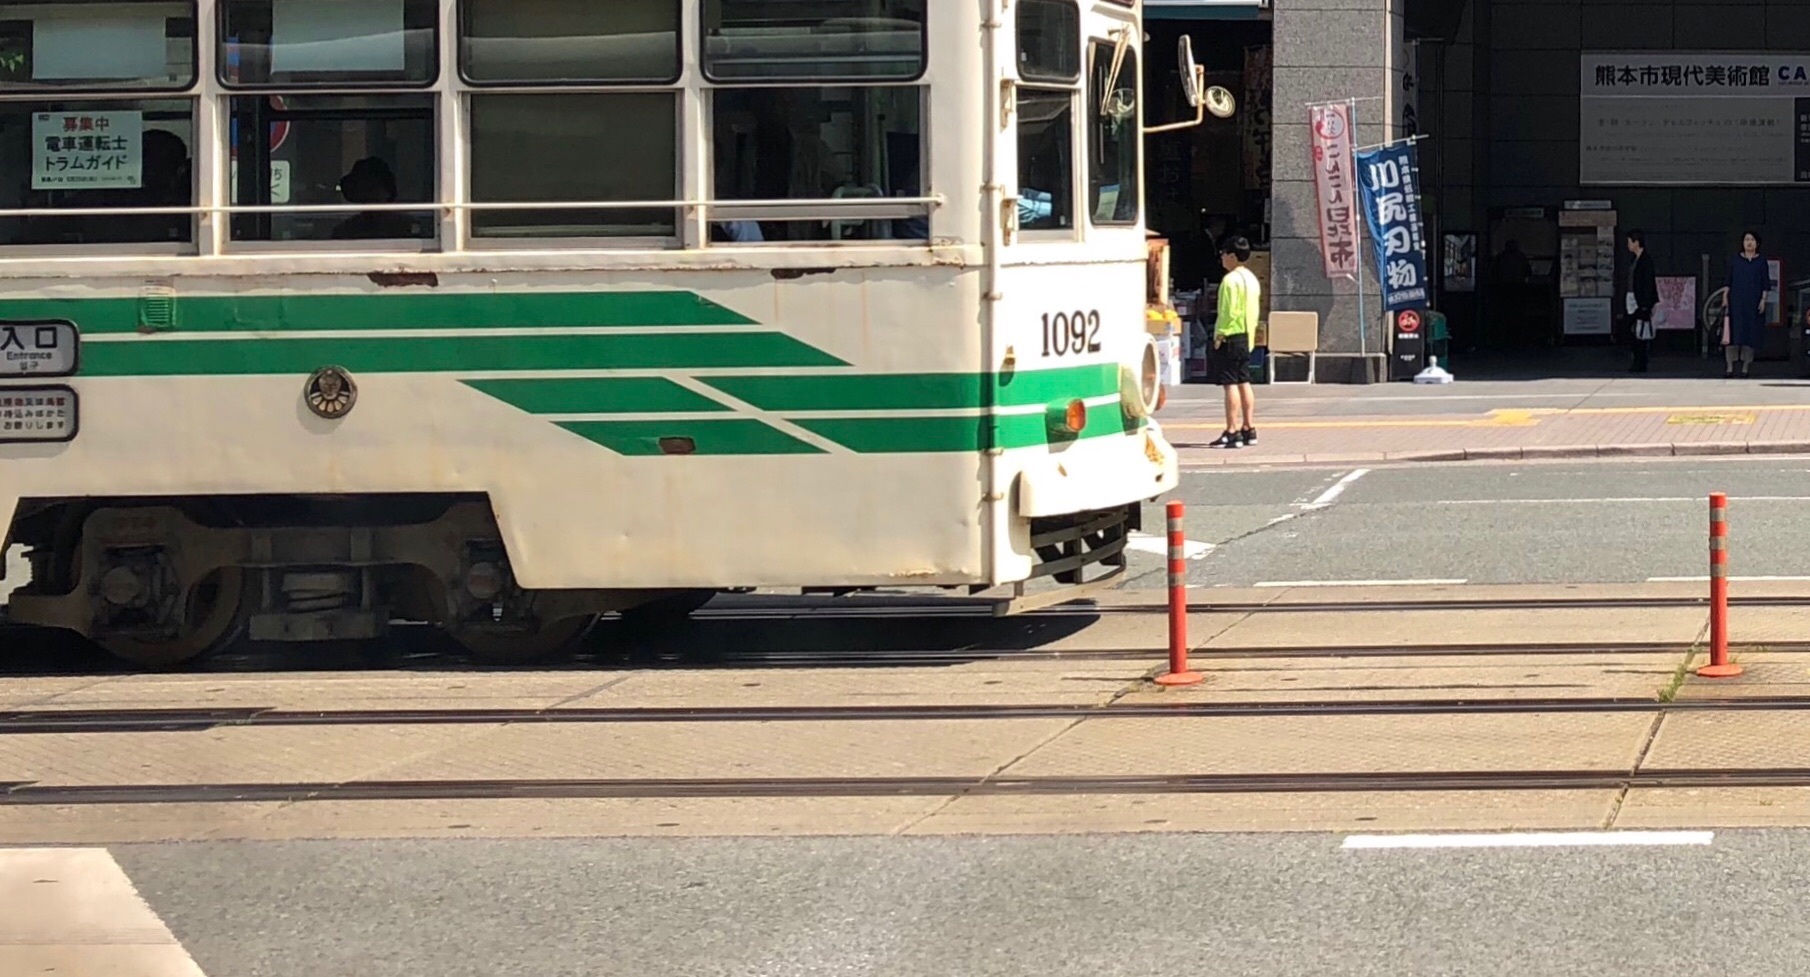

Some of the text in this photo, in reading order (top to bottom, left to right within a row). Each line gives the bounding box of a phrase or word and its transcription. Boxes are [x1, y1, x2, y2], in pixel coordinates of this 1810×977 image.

[1595, 65, 1770, 87] 熊本市現代美術館
[63, 116, 109, 132] 募集中
[45, 135, 128, 153] 電車運転士
[46, 155, 128, 172] トラムガイド
[1369, 159, 1418, 290] 川尻刃物
[0, 326, 58, 351] 入口
[1041, 309, 1102, 357] 1092
[6, 351, 53, 361] Entrance
